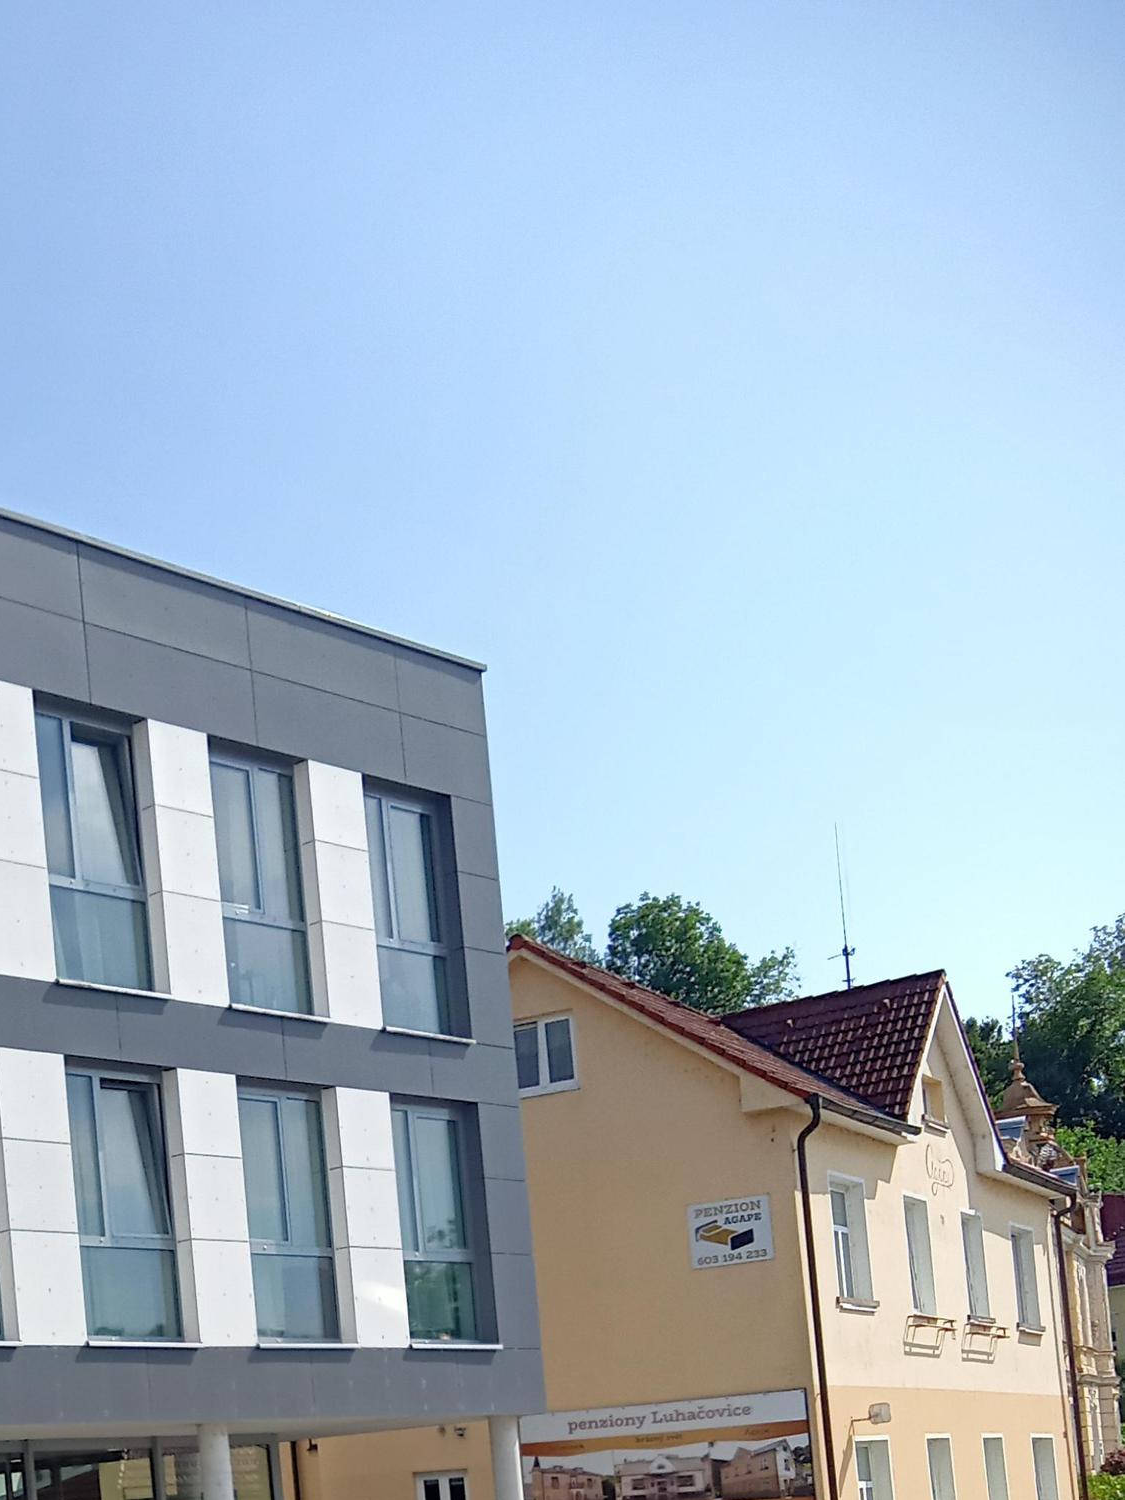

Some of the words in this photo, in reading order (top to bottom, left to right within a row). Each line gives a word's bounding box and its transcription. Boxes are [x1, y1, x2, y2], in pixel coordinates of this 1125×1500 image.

[694, 1200, 762, 1219] PENZION
[723, 1212, 762, 1225] AGAPE
[697, 1255, 719, 1265] 603
[722, 1251, 743, 1262] 194
[746, 1248, 768, 1259] 233
[567, 1414, 646, 1434] penziony
[651, 1403, 752, 1424] Luhačovice
